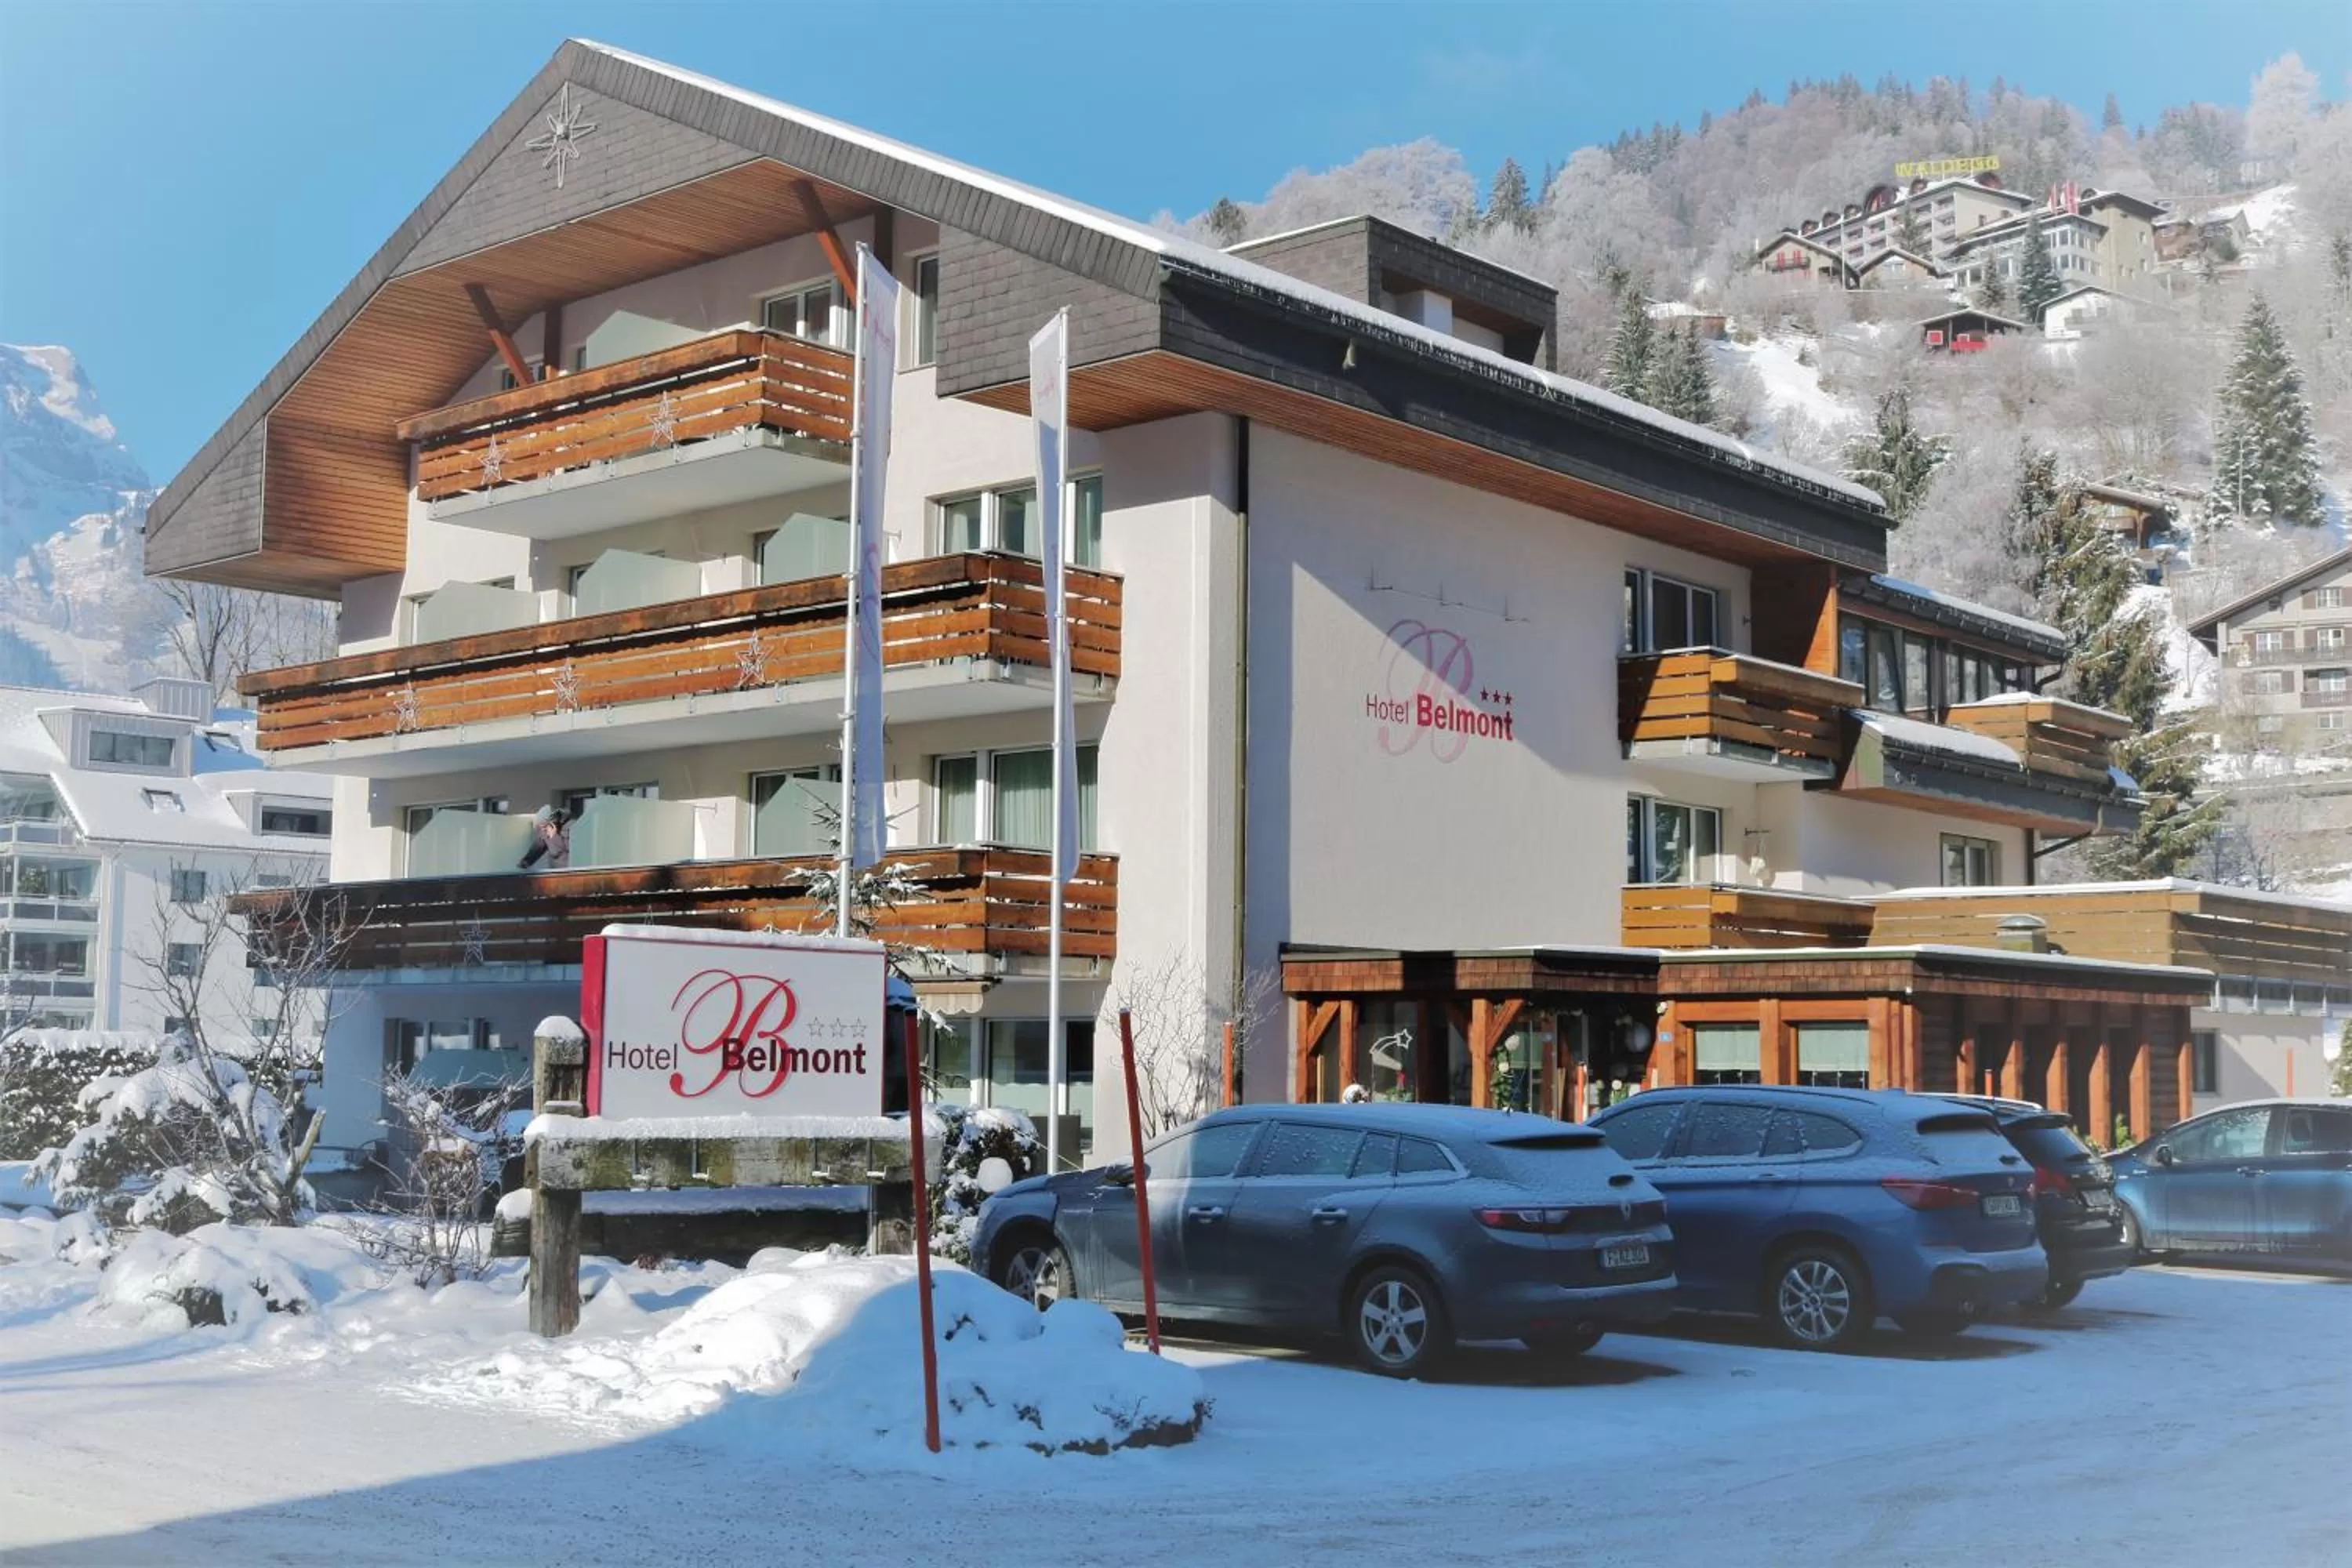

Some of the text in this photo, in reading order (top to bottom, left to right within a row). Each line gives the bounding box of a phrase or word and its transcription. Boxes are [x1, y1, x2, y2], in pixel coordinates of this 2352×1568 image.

[1367, 694, 1514, 740] Hotel Belmont
[608, 1038, 866, 1073] Hotel Belmont
